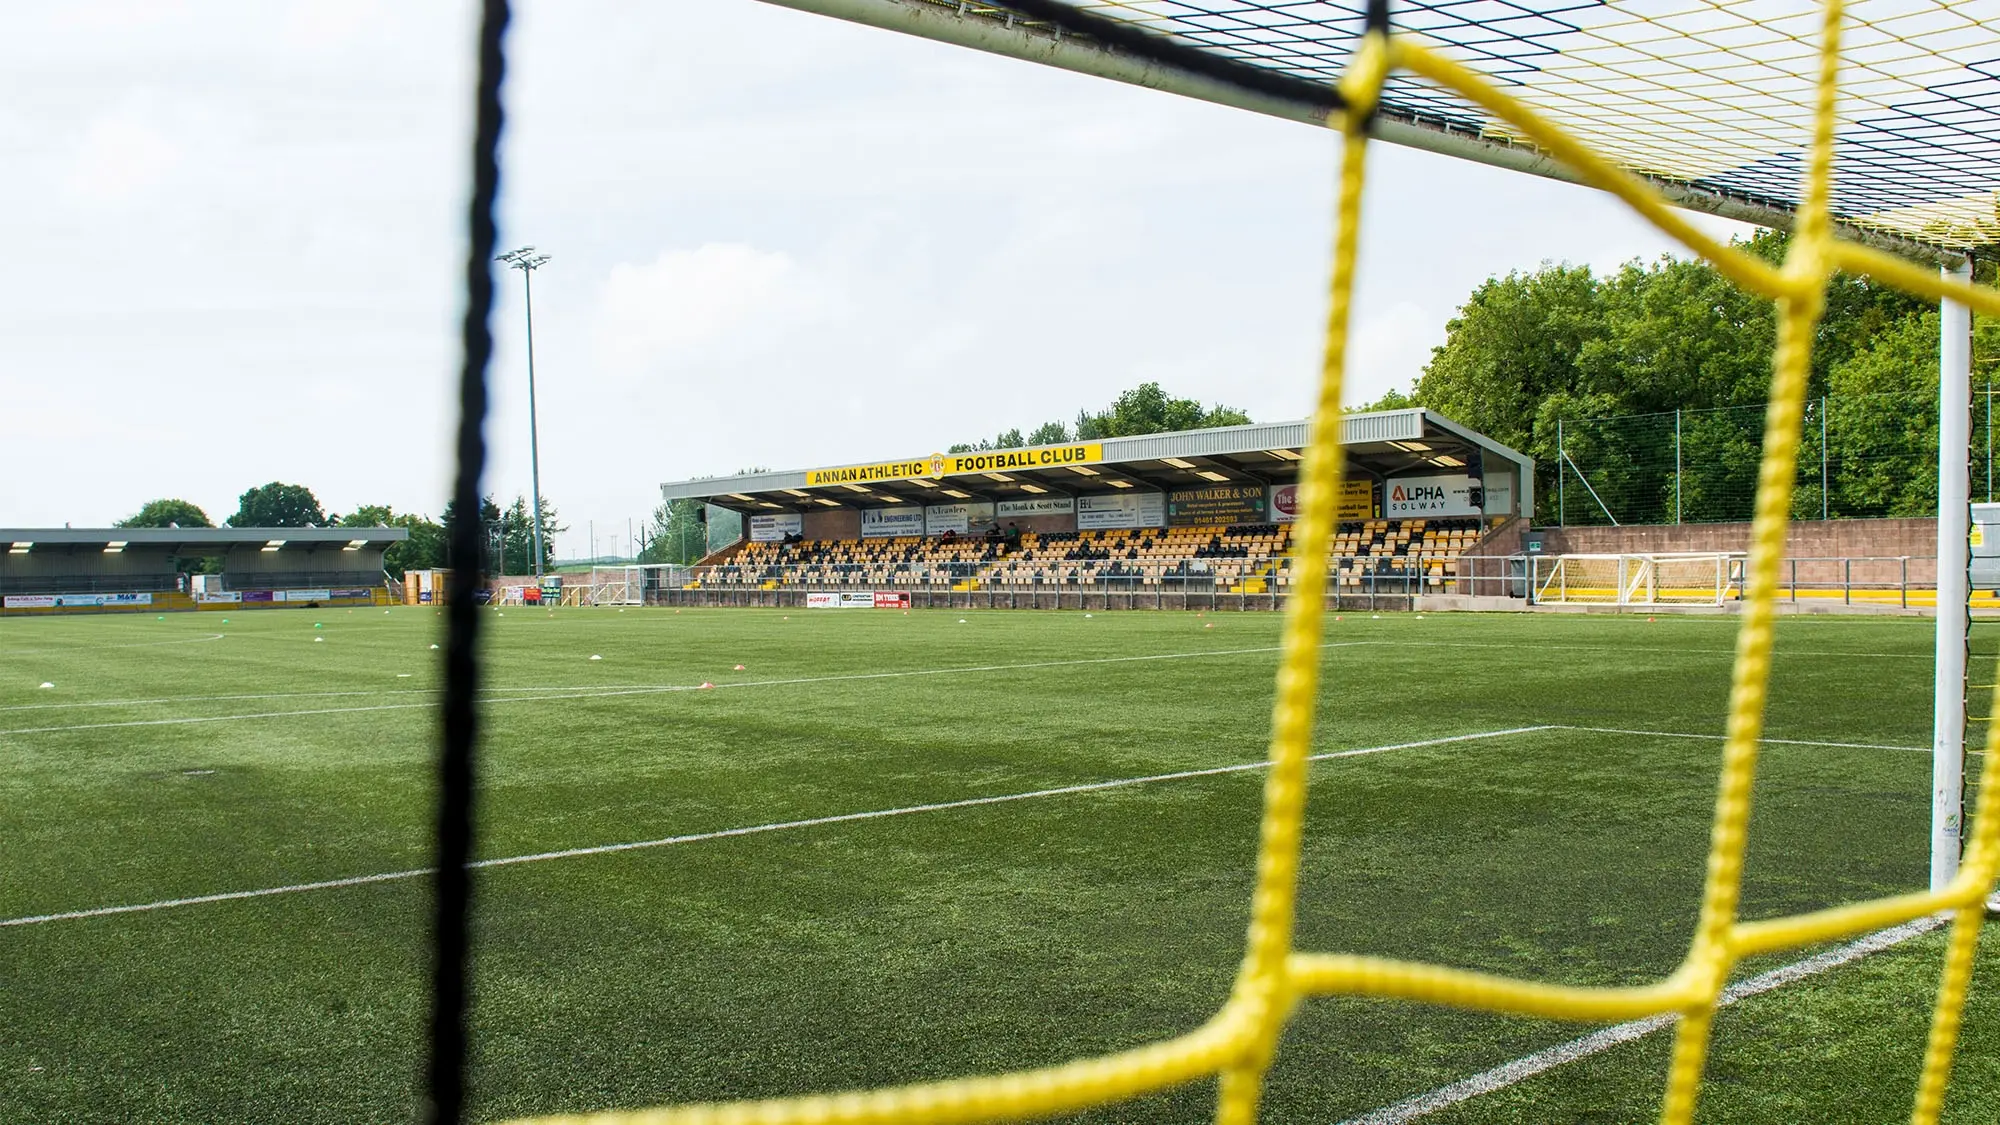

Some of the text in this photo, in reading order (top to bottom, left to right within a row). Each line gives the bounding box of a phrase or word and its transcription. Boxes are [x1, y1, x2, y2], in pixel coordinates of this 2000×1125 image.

[814, 447, 1086, 484] ANNAN ATHLETIC FOOTBALL CLUB
[1171, 487, 1262, 502] JOHN WALKER & SON
[1277, 494, 1292, 504] The
[1391, 485, 1445, 501] ALPHA
[1000, 503, 1010, 512] The
[1029, 502, 1035, 510] &
[1053, 500, 1071, 509] Stand
[1392, 501, 1446, 511] SOLWAY
[884, 514, 913, 523] ENGINEERING
[913, 513, 922, 522] LTD
